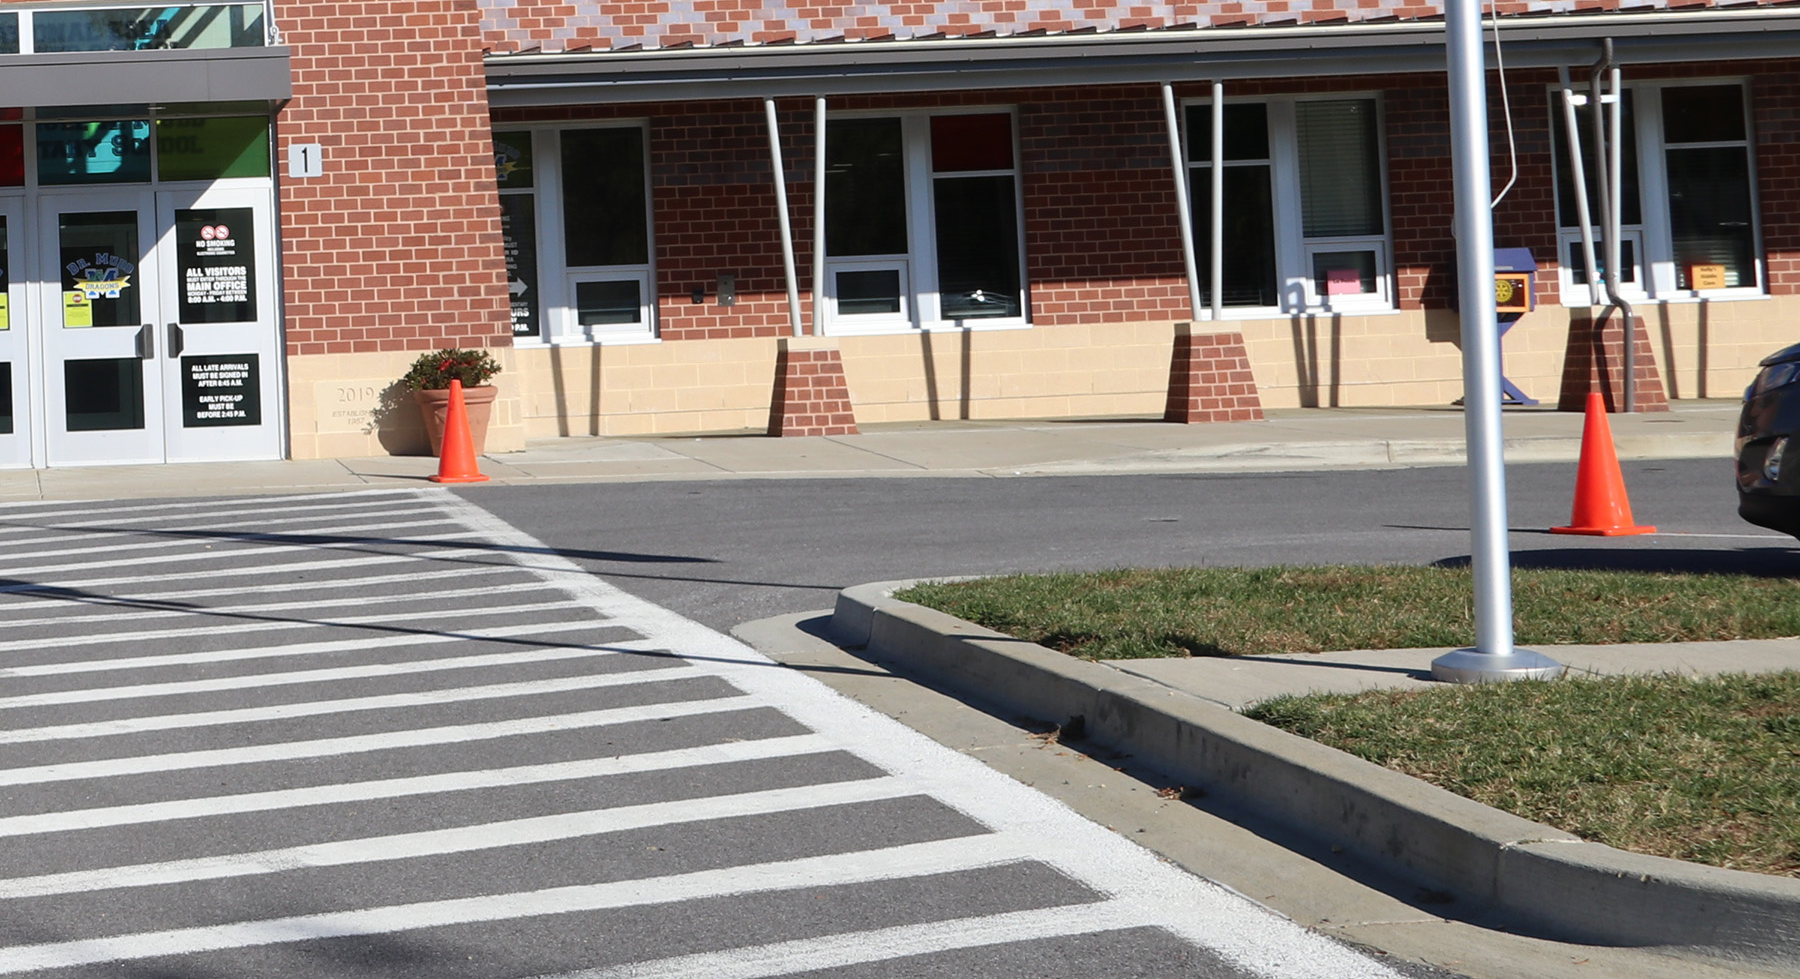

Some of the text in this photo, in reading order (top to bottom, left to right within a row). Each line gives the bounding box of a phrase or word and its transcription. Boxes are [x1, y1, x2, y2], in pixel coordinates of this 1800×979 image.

[301, 147, 308, 173] 1
[186, 266, 247, 277] ALL VISITORS
[85, 282, 119, 290] DRAGONS
[187, 281, 247, 291] MAIN OFFICE
[220, 363, 249, 371] ARRIVALS
[219, 371, 241, 379] SIGNED
[199, 394, 244, 403] EARLY PICK-UP
[337, 386, 375, 402] 2019
[197, 411, 221, 419] BEFORE
[331, 409, 375, 419] ESTABLISH
